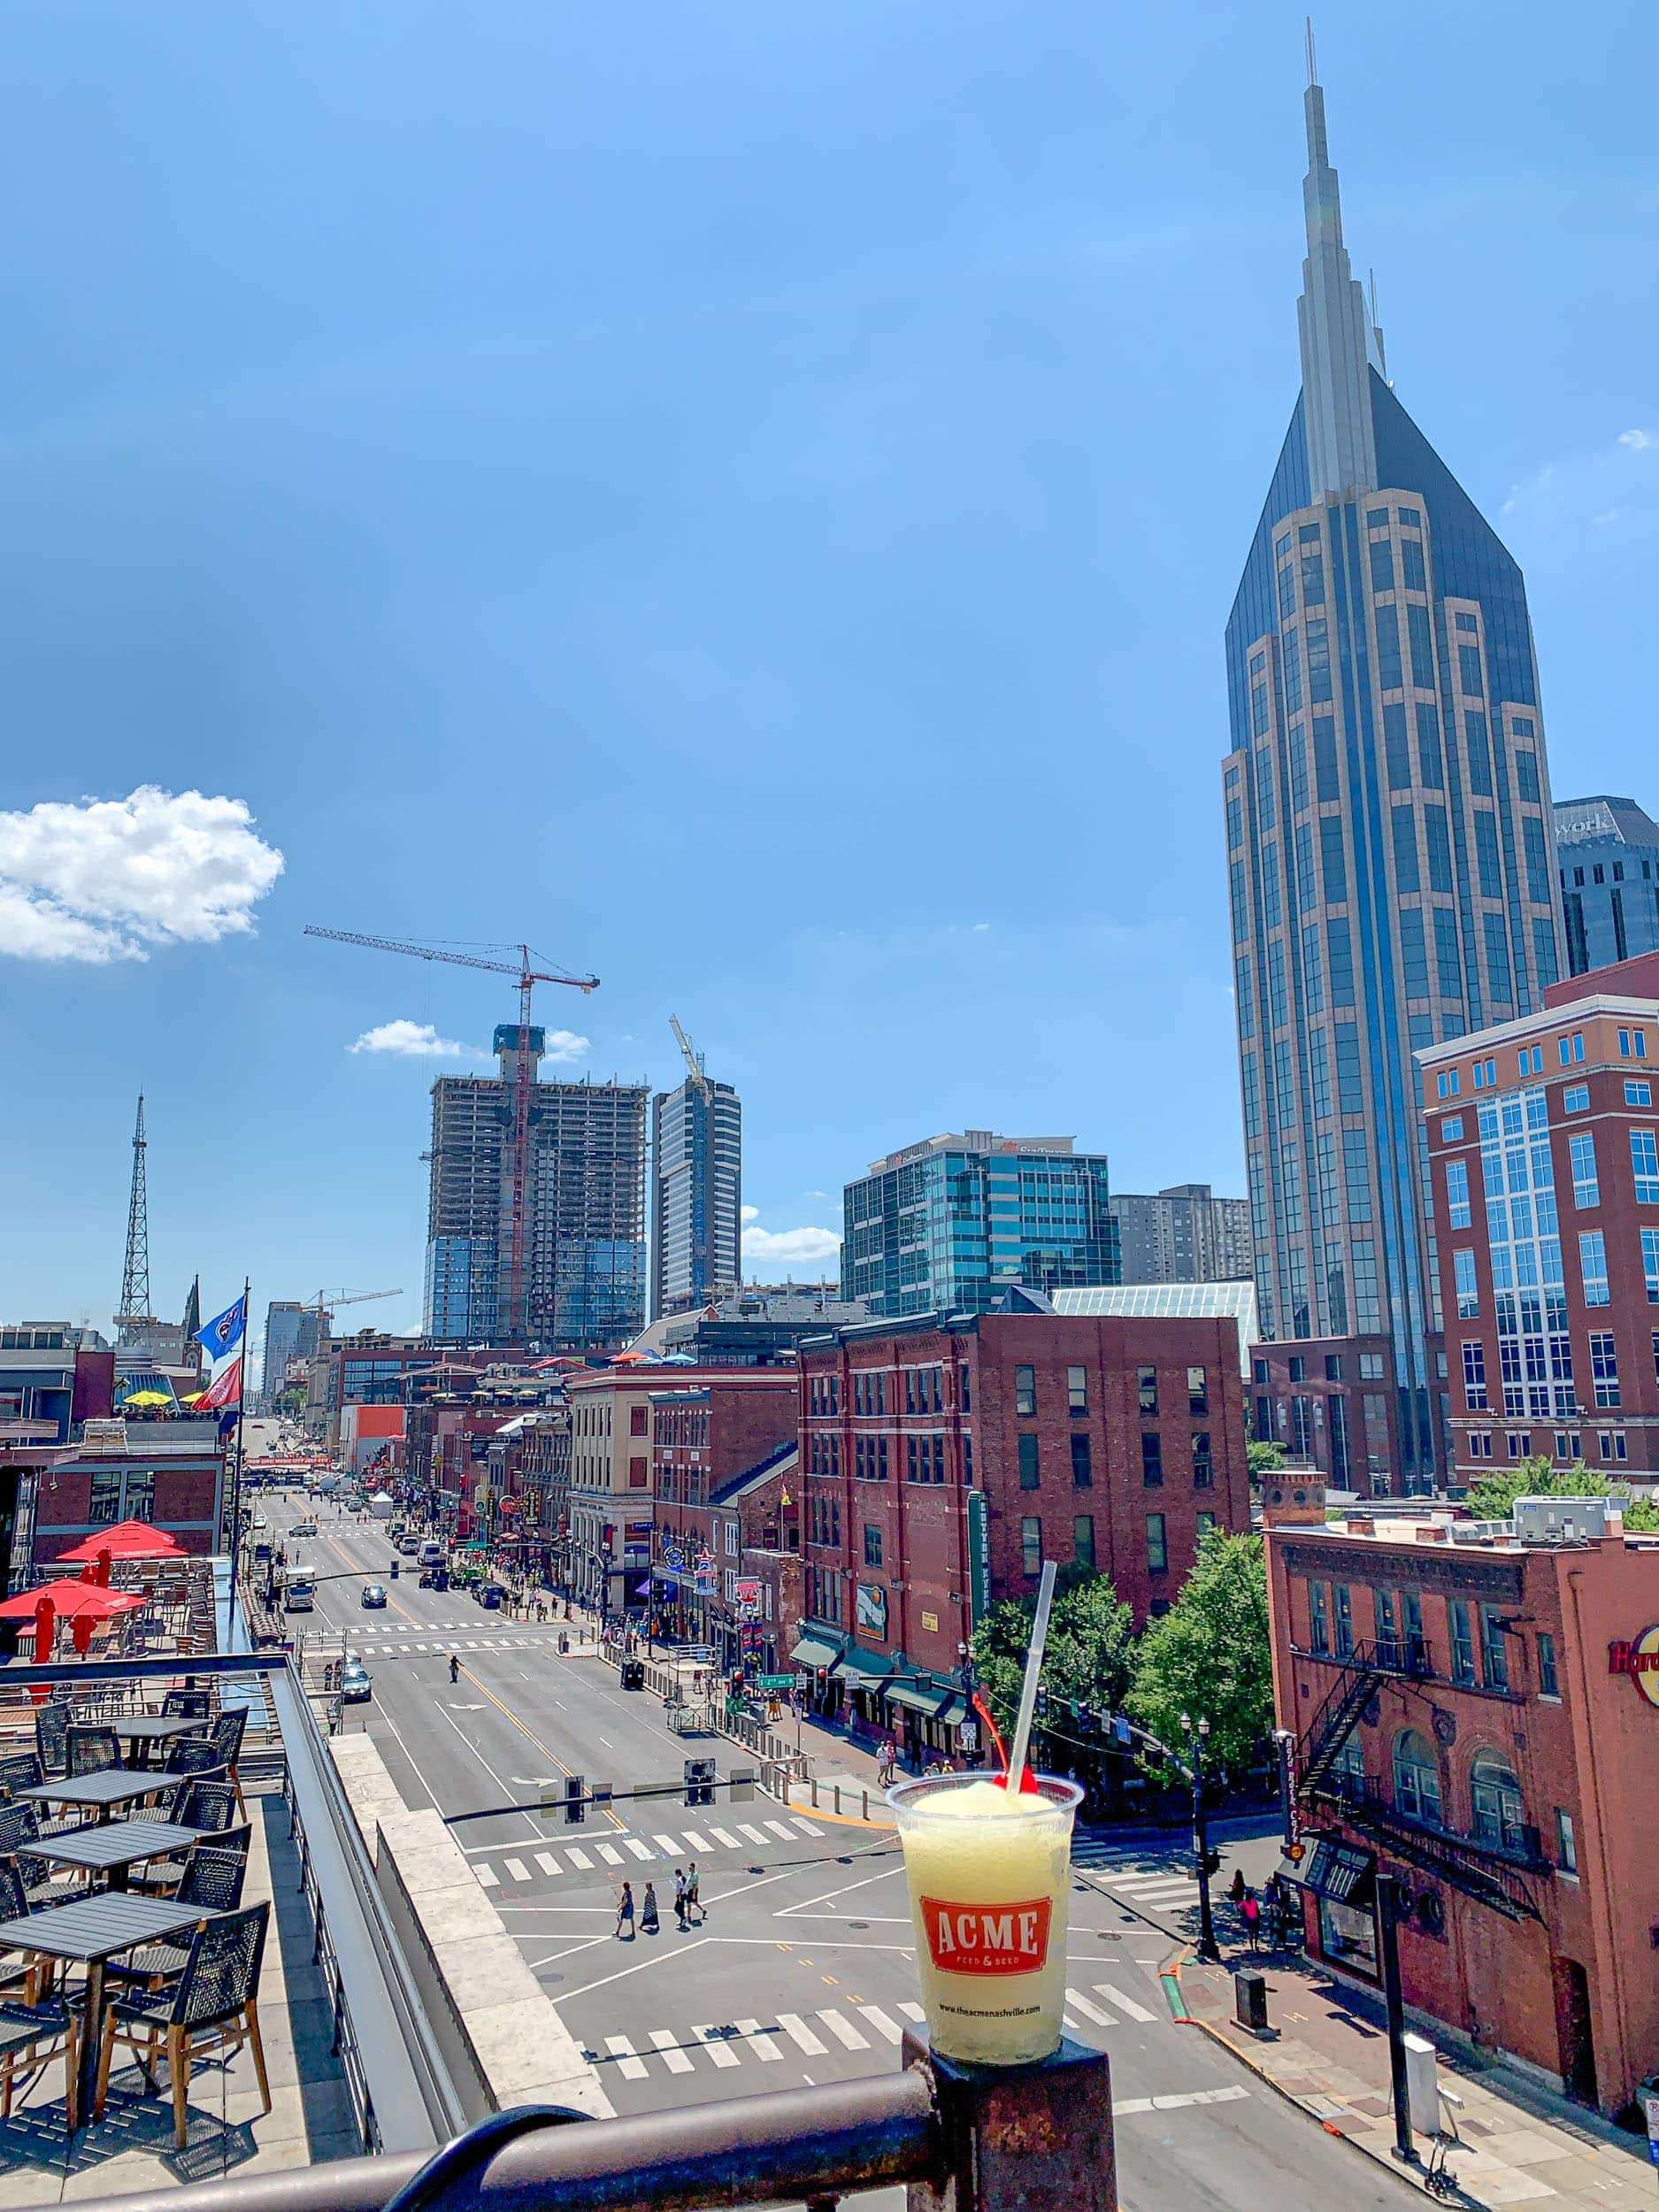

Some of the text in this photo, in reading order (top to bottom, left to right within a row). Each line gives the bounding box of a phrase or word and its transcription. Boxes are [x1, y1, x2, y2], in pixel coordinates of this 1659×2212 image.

[938, 1911, 1038, 1955] ACME
[956, 1955, 1019, 1967] FEED & SEED
[939, 2003, 1041, 2018] www.theacmenashville.com
